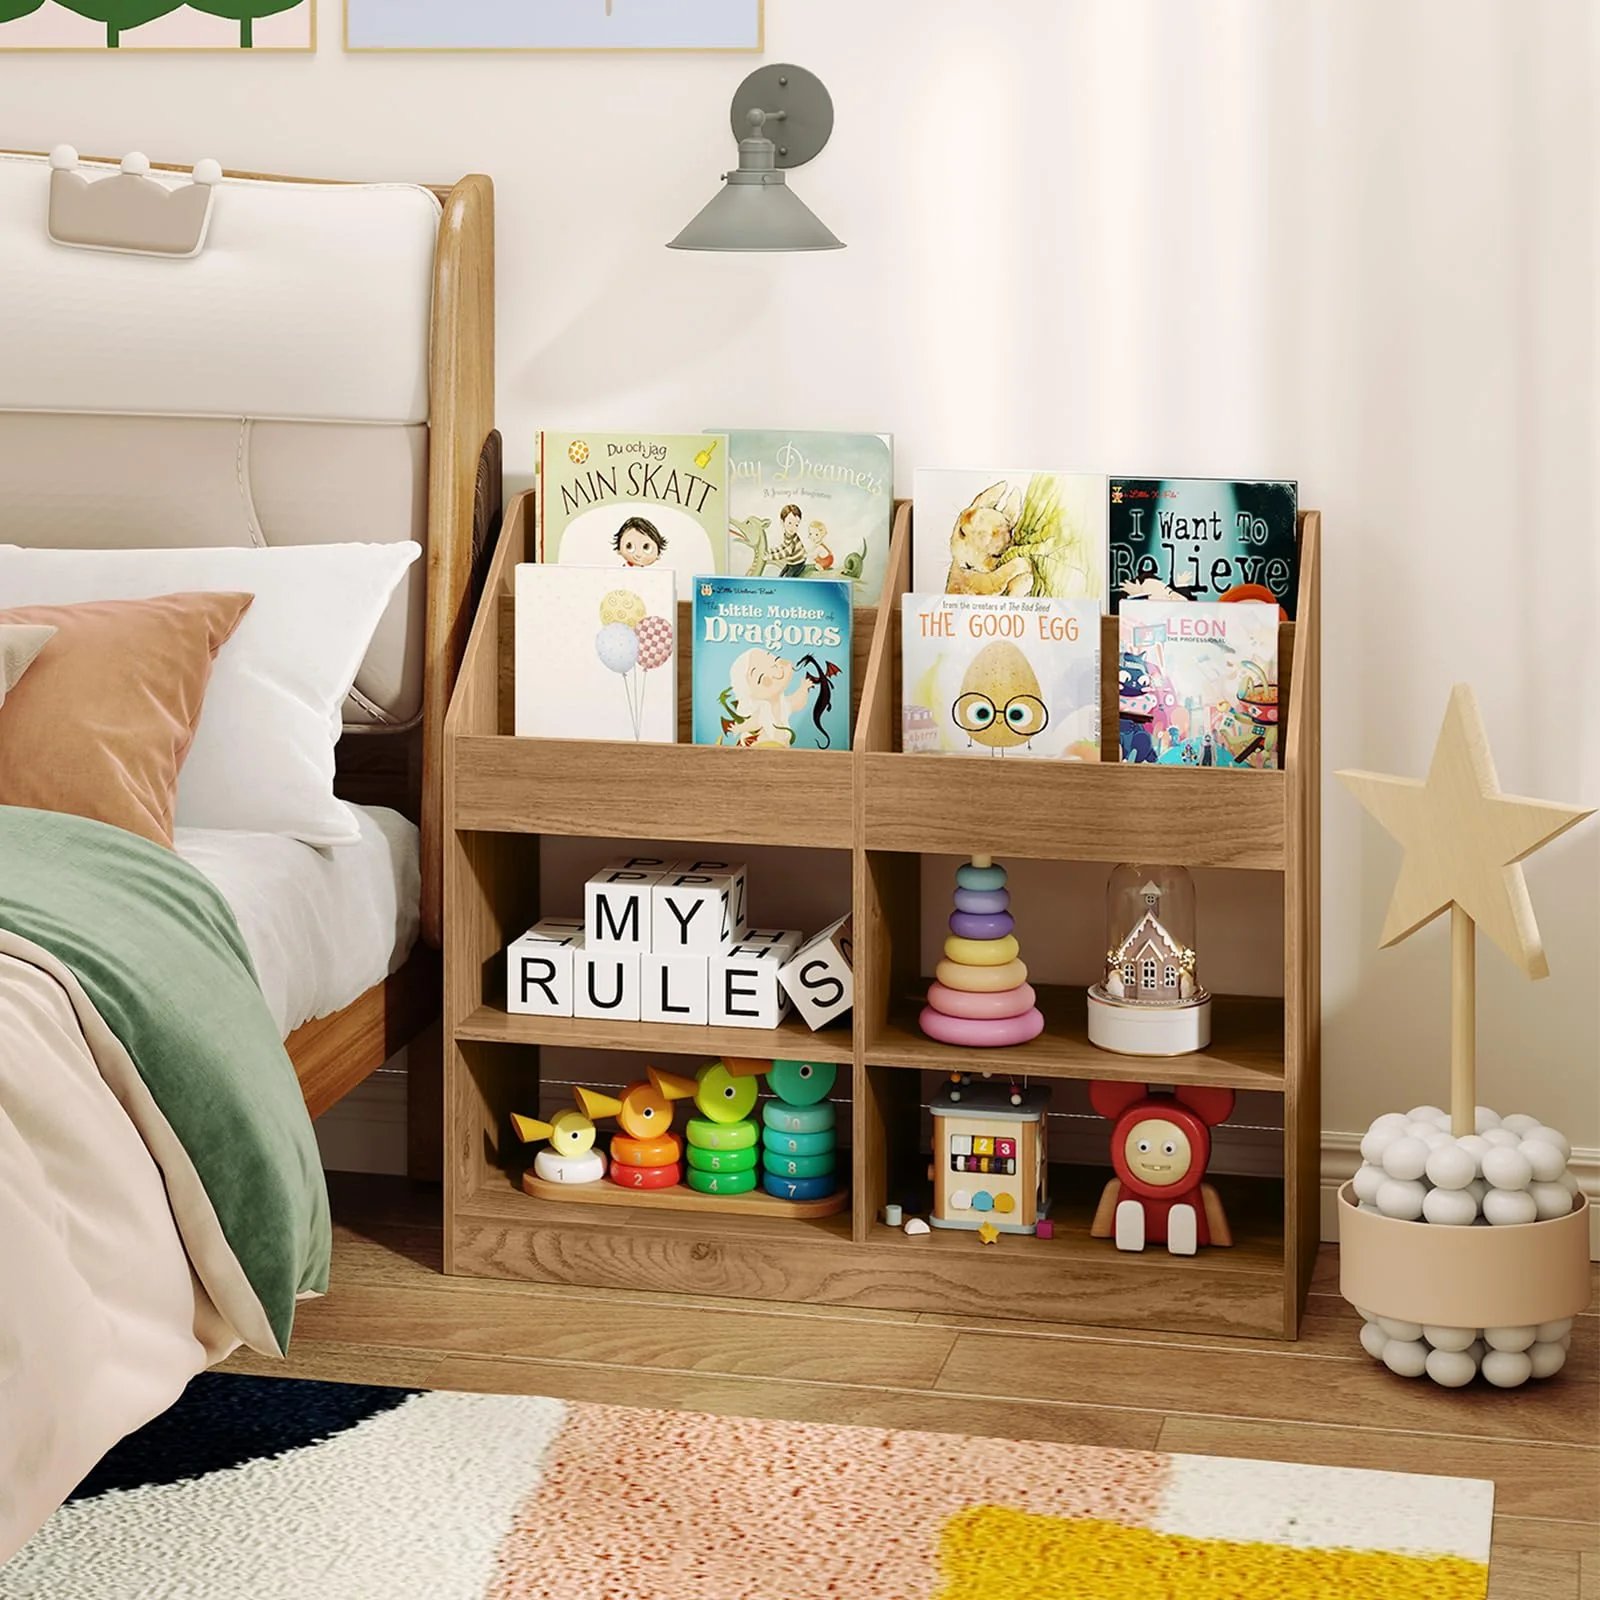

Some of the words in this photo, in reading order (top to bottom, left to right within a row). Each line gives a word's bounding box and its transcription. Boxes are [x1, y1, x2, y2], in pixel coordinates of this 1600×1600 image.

[607, 443, 623, 457] Du
[626, 441, 646, 454] och
[642, 442, 667, 461] jag
[729, 457, 762, 485] ay
[772, 440, 883, 496] Dreamers
[561, 466, 617, 516] MIN
[626, 461, 718, 514] SKATT
[1129, 508, 1145, 541] I
[1158, 511, 1222, 541] Want
[1236, 512, 1269, 546] To
[718, 603, 763, 618] Little
[767, 606, 824, 620] Mother
[960, 601, 970, 610] the
[1008, 602, 1021, 612] The
[1022, 603, 1034, 612] Bad
[1035, 603, 1051, 613] Seed
[704, 616, 842, 651] Dragons
[919, 612, 956, 638] THE
[969, 614, 1025, 639] GOOD
[1038, 616, 1079, 641] EGG
[1167, 618, 1226, 637] LEON
[595, 893, 705, 945] MY
[785, 1117, 800, 1130] 10
[979, 1139, 989, 1151] 2
[1001, 1143, 1011, 1155] 3
[712, 1157, 720, 1170] 5
[788, 1162, 797, 1174] 8
[557, 1169, 564, 1180] 1
[633, 1173, 643, 1186] 2
[709, 1179, 718, 1191] 4
[788, 1184, 797, 1197] 7
